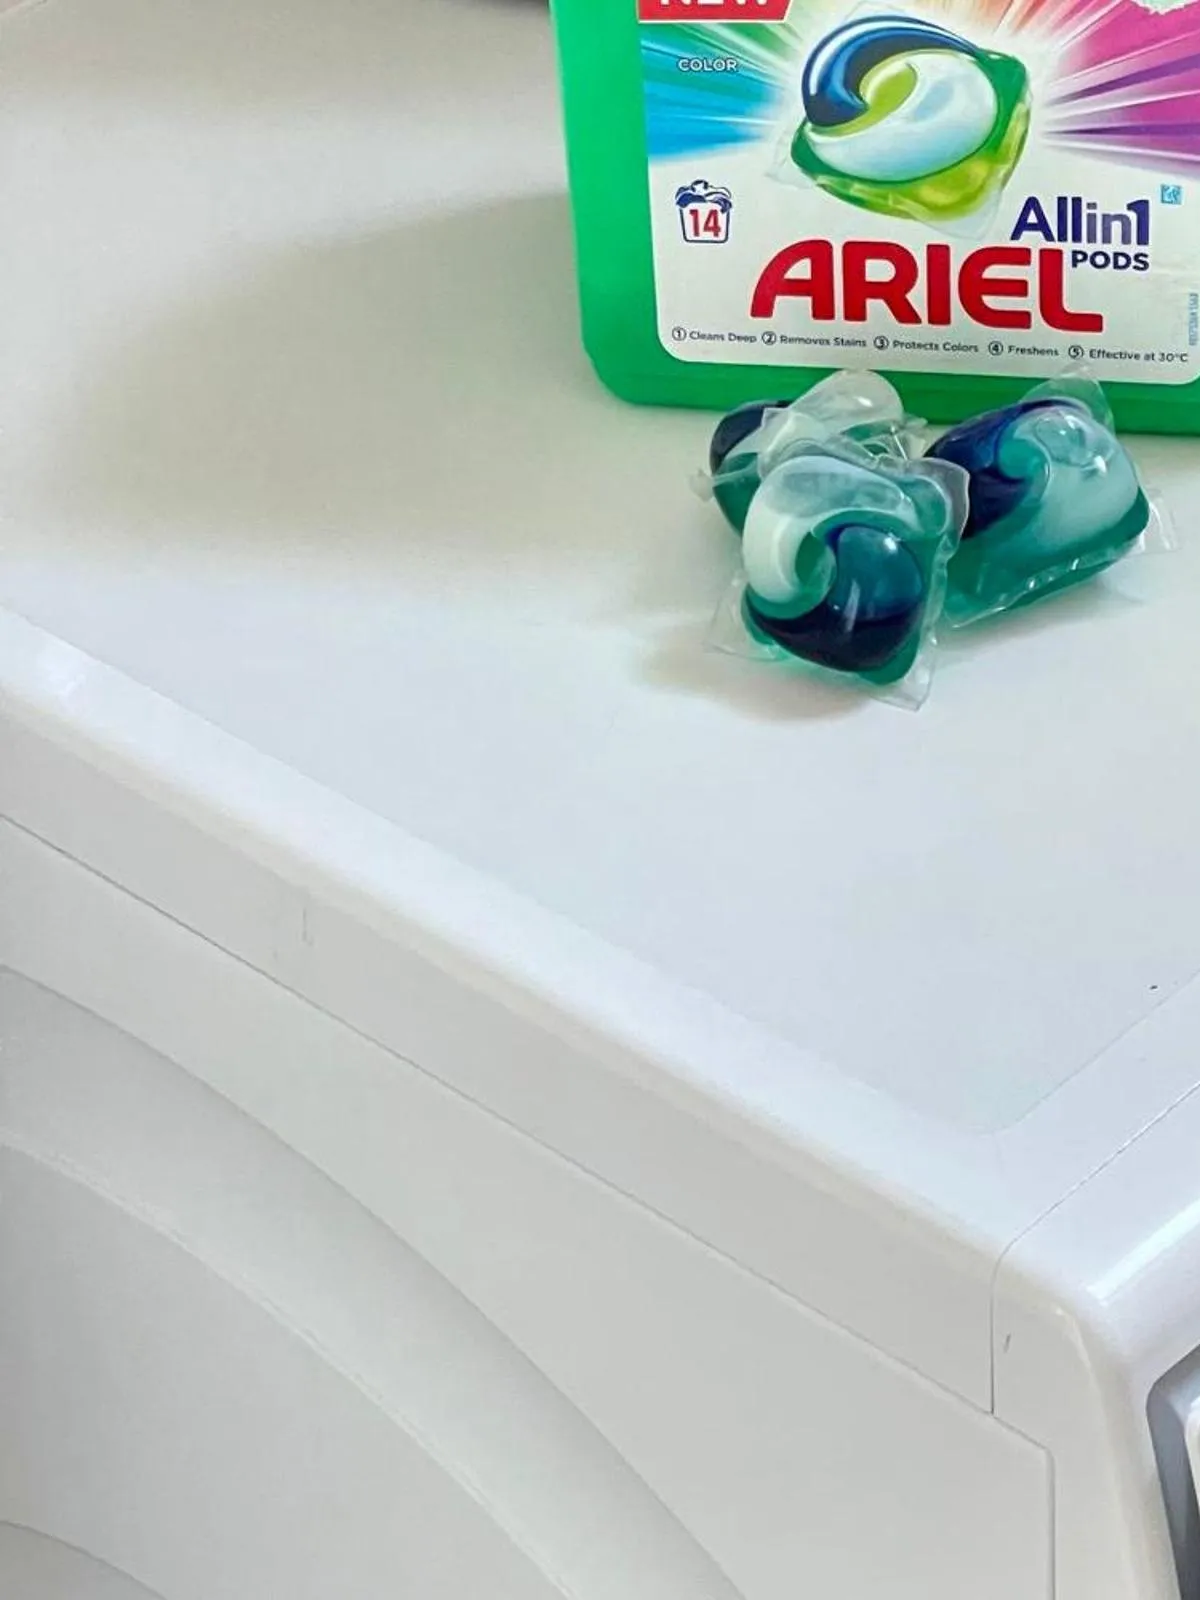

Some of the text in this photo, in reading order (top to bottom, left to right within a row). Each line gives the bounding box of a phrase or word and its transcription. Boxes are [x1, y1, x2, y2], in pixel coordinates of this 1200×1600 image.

[678, 58, 738, 72] COLOR
[689, 208, 721, 237] 14
[1072, 250, 1150, 272] PODS
[750, 239, 1104, 333] ARIEL
[689, 331, 725, 342] Cleans
[728, 333, 757, 344] Deep
[780, 335, 831, 347] Removes
[833, 337, 867, 348] Stains
[892, 339, 940, 351] Protects
[942, 341, 979, 353] Colors
[1008, 345, 1059, 357] Freshens
[1089, 349, 1140, 361] Effective
[1143, 351, 1155, 361] at
[1158, 352, 1189, 363] 30°C
